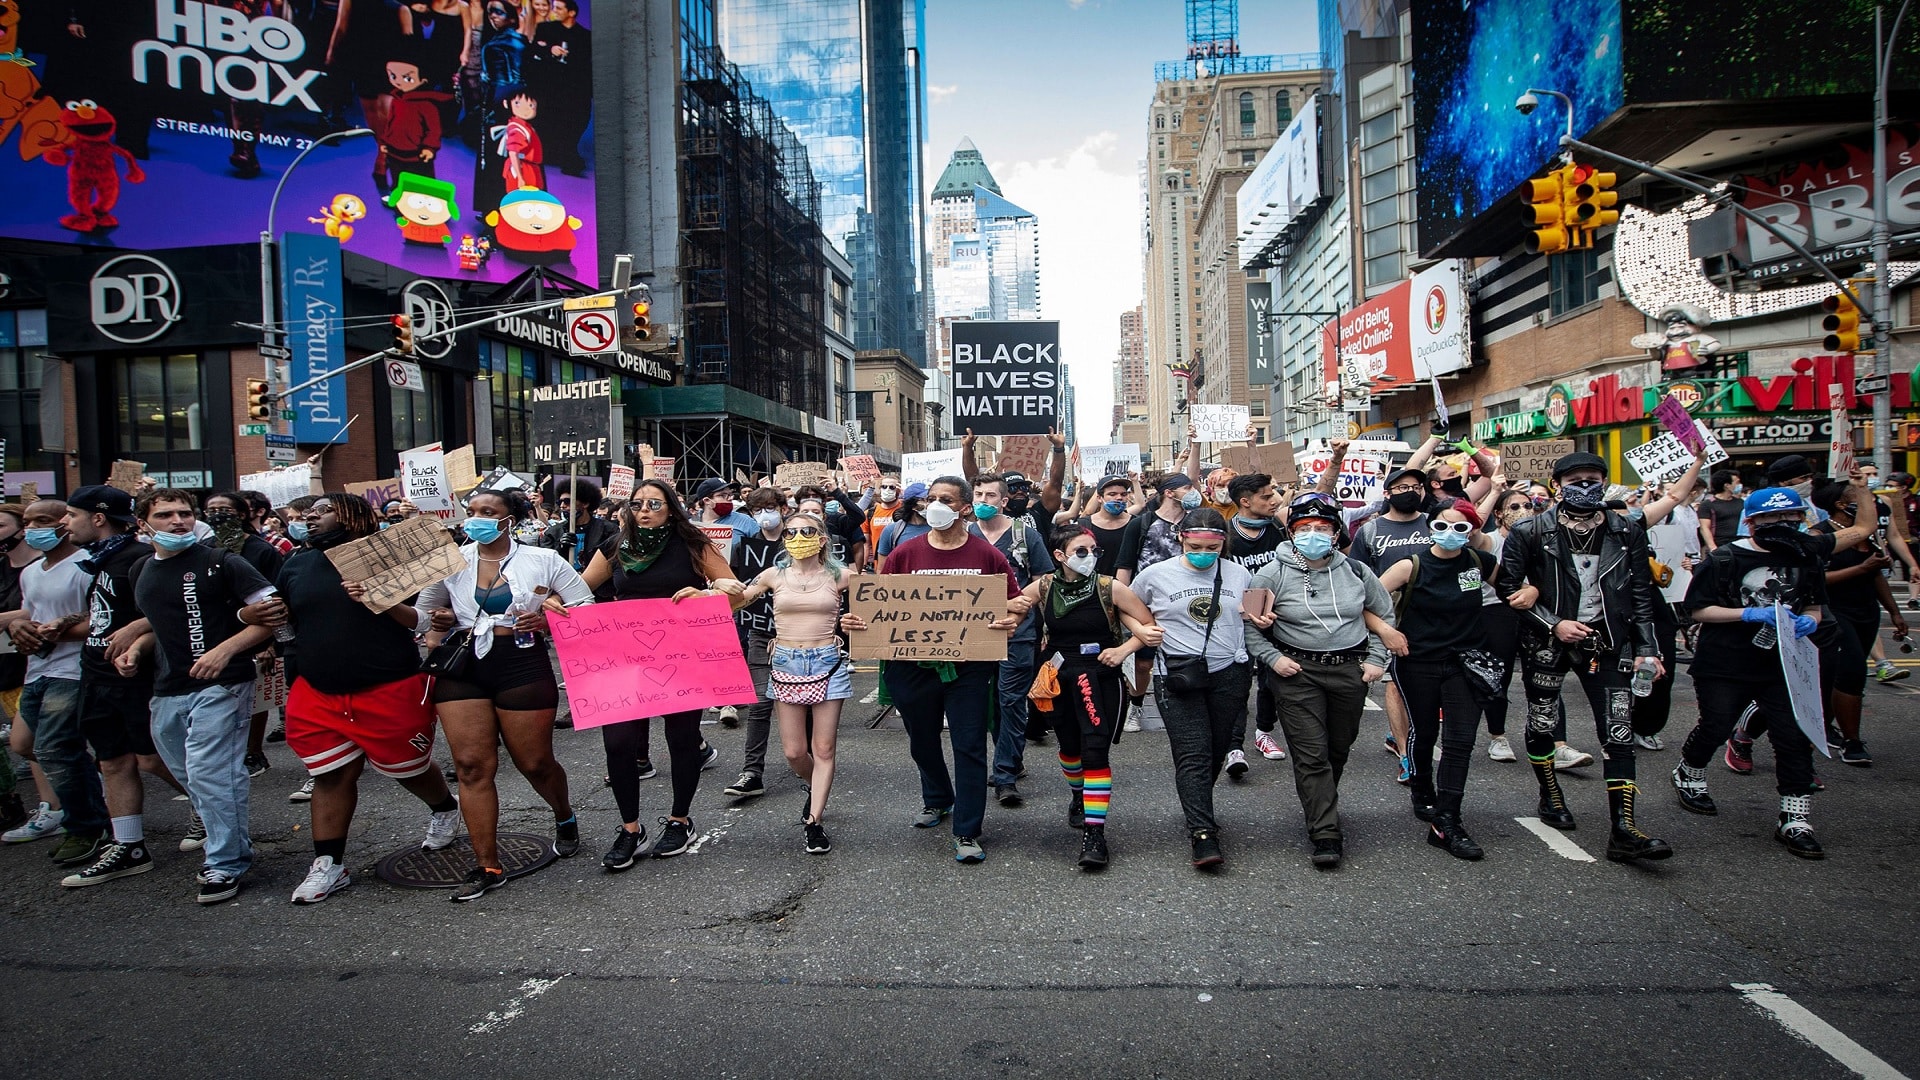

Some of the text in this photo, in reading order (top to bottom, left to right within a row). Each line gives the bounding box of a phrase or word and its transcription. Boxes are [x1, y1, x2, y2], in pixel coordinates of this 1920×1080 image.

[155, 0, 306, 62] HBO
[132, 39, 322, 113] max
[156, 118, 312, 150] STREAMING MAY 27
[1780, 151, 1913, 198] DALLS
[956, 247, 979, 257] RIU
[1753, 263, 1789, 278] RIBS
[91, 274, 184, 325] DR
[496, 310, 552, 346] DUANE
[1250, 297, 1269, 369] WESTIN
[1337, 306, 1389, 341] ired Of Being
[1363, 322, 1394, 351] Online?
[1417, 334, 1458, 359] DuckDuckGo
[299, 295, 342, 425] pharmacy
[618, 351, 647, 375] OPEN
[955, 343, 1055, 364] BLACK
[955, 371, 1055, 389] LIVES
[956, 395, 1055, 417] MATTER
[1191, 405, 1248, 414] NO MORE
[1545, 400, 1567, 418] villa
[1570, 374, 1643, 428] villa
[1192, 414, 1237, 423] RACIST
[1502, 412, 1533, 437] SALADS
[1754, 423, 1813, 438] FOOD
[535, 437, 606, 462] NO PEACE
[1505, 443, 1569, 457] NO JUSTICE
[1625, 436, 1671, 460] REFORM
[1775, 436, 1809, 444] SQUARE
[411, 466, 438, 476] BLACK
[795, 463, 825, 473] PEOPLE
[999, 457, 1043, 475] COPS
[1504, 458, 1556, 473] NO PEAC
[1638, 458, 1668, 477] FUCK
[241, 475, 258, 484] SAY
[411, 477, 436, 487] LIVES
[410, 487, 440, 498] MATTER
[1375, 531, 1435, 557] Yankees
[856, 582, 985, 607] EQUALITY
[1169, 592, 1182, 603] HIGH
[1184, 588, 1198, 597] TECH
[183, 582, 206, 662] INDEPENDEN
[556, 613, 735, 640] Black lives are worthy
[871, 609, 995, 625] AND NOTHING
[889, 627, 946, 644] LESS
[565, 647, 743, 678] Black lives are beloved
[275, 660, 284, 706] BRUTALITY
[574, 684, 753, 719] Black lives are needed
